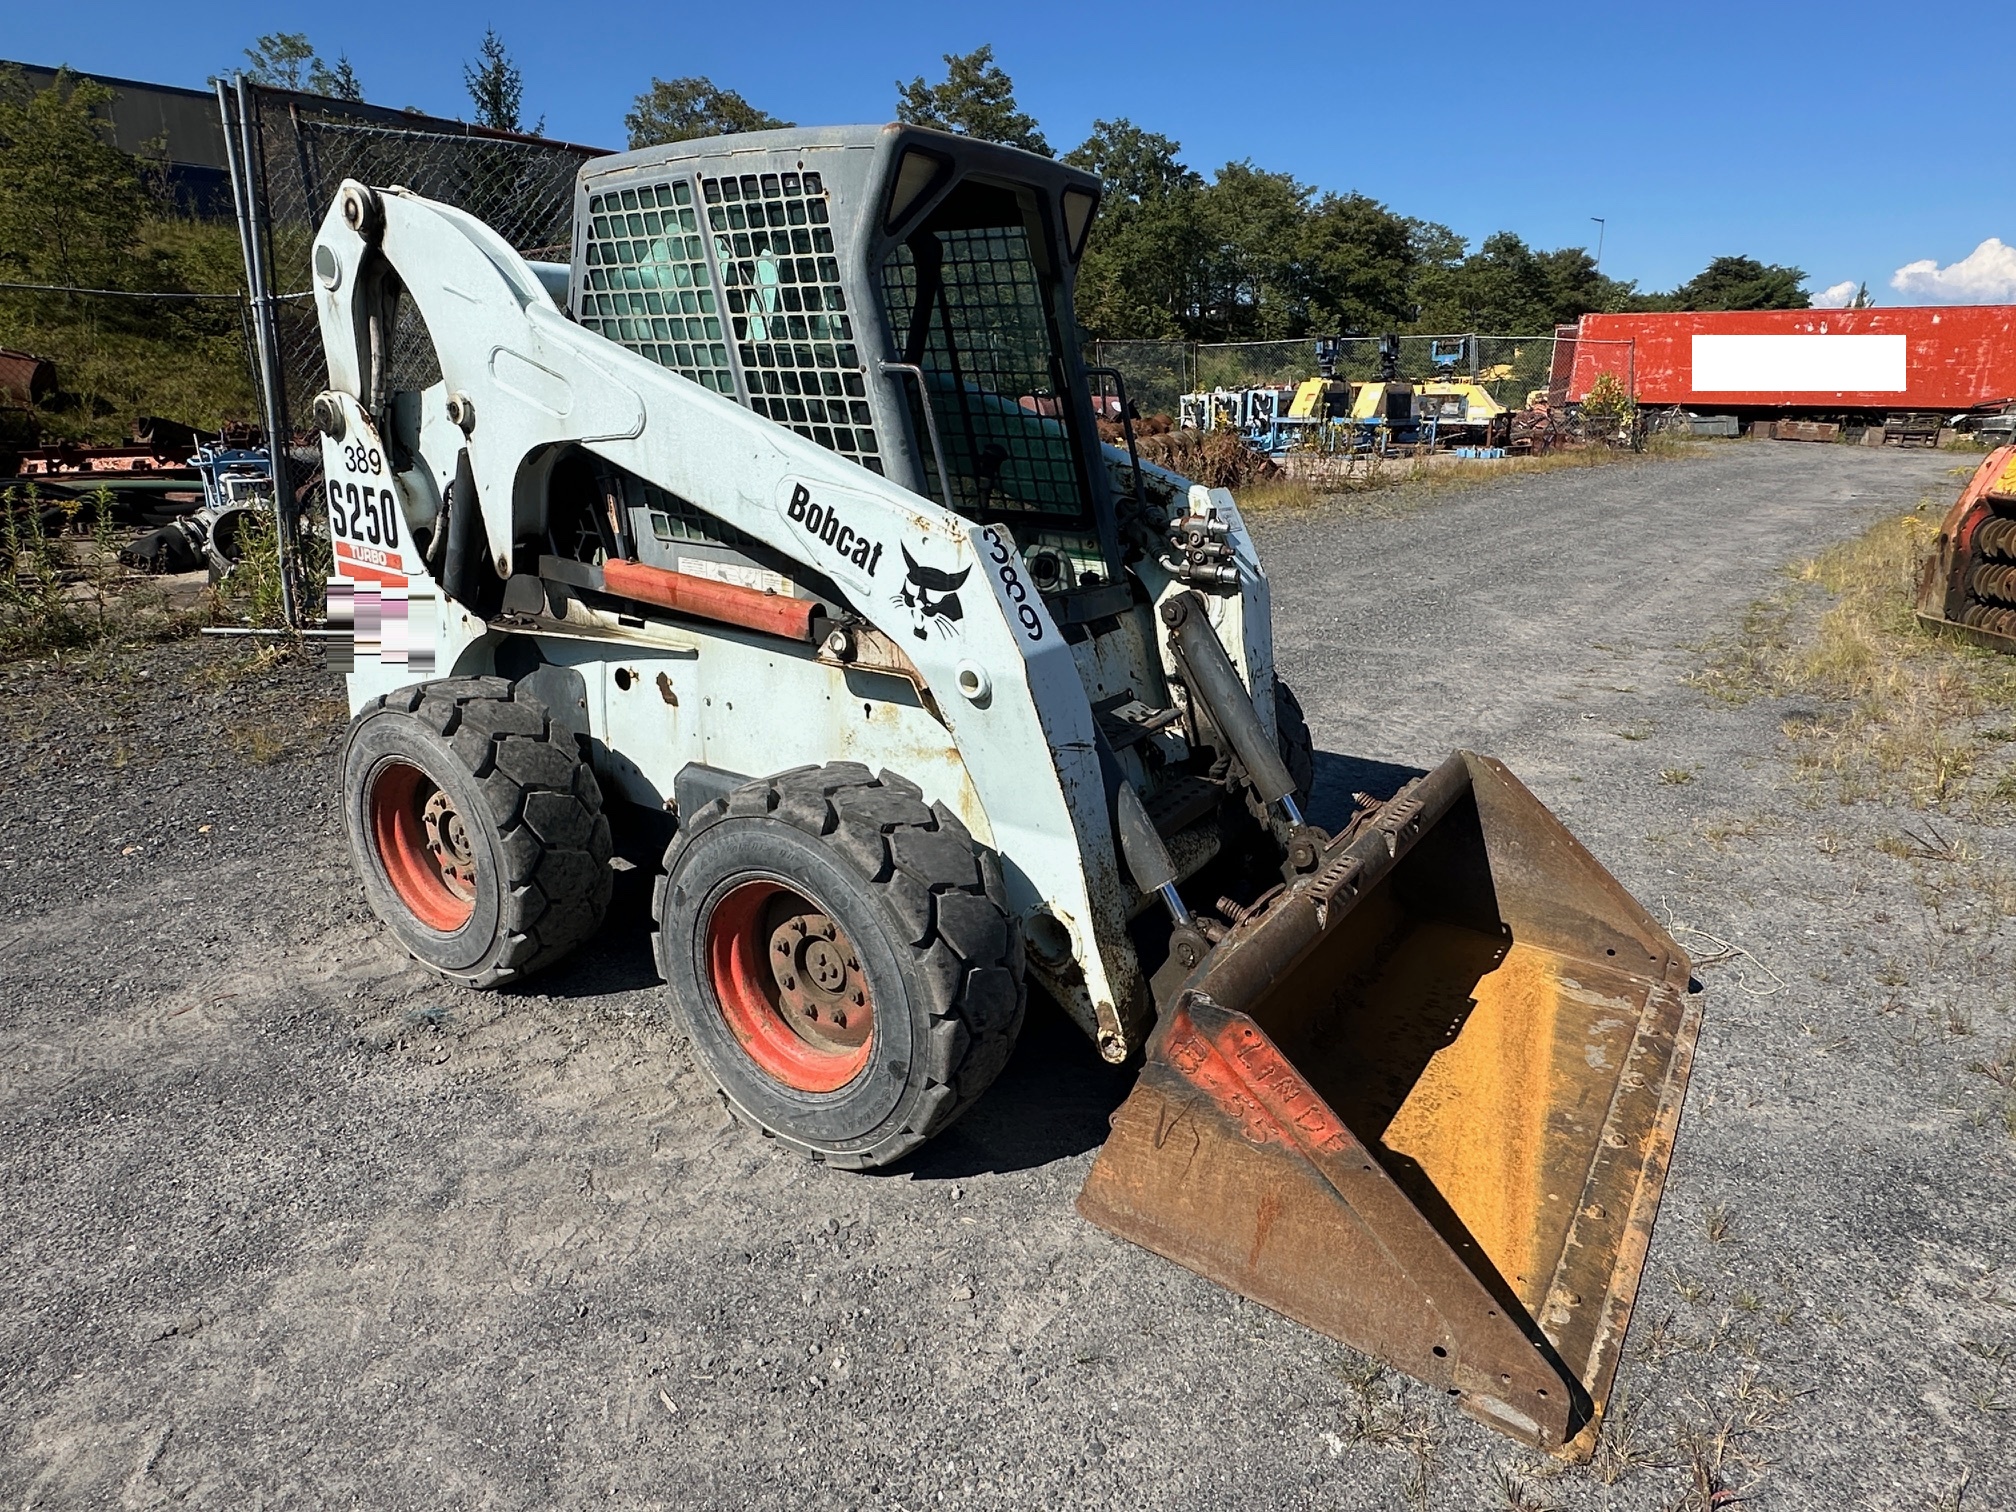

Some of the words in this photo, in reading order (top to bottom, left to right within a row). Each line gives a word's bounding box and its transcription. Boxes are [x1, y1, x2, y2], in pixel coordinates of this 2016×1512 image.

[345, 445, 382, 475] 389
[329, 479, 399, 549] S250
[787, 482, 883, 578] Bobcat
[351, 546, 386, 565] TURBO
[982, 527, 1043, 641] 389
